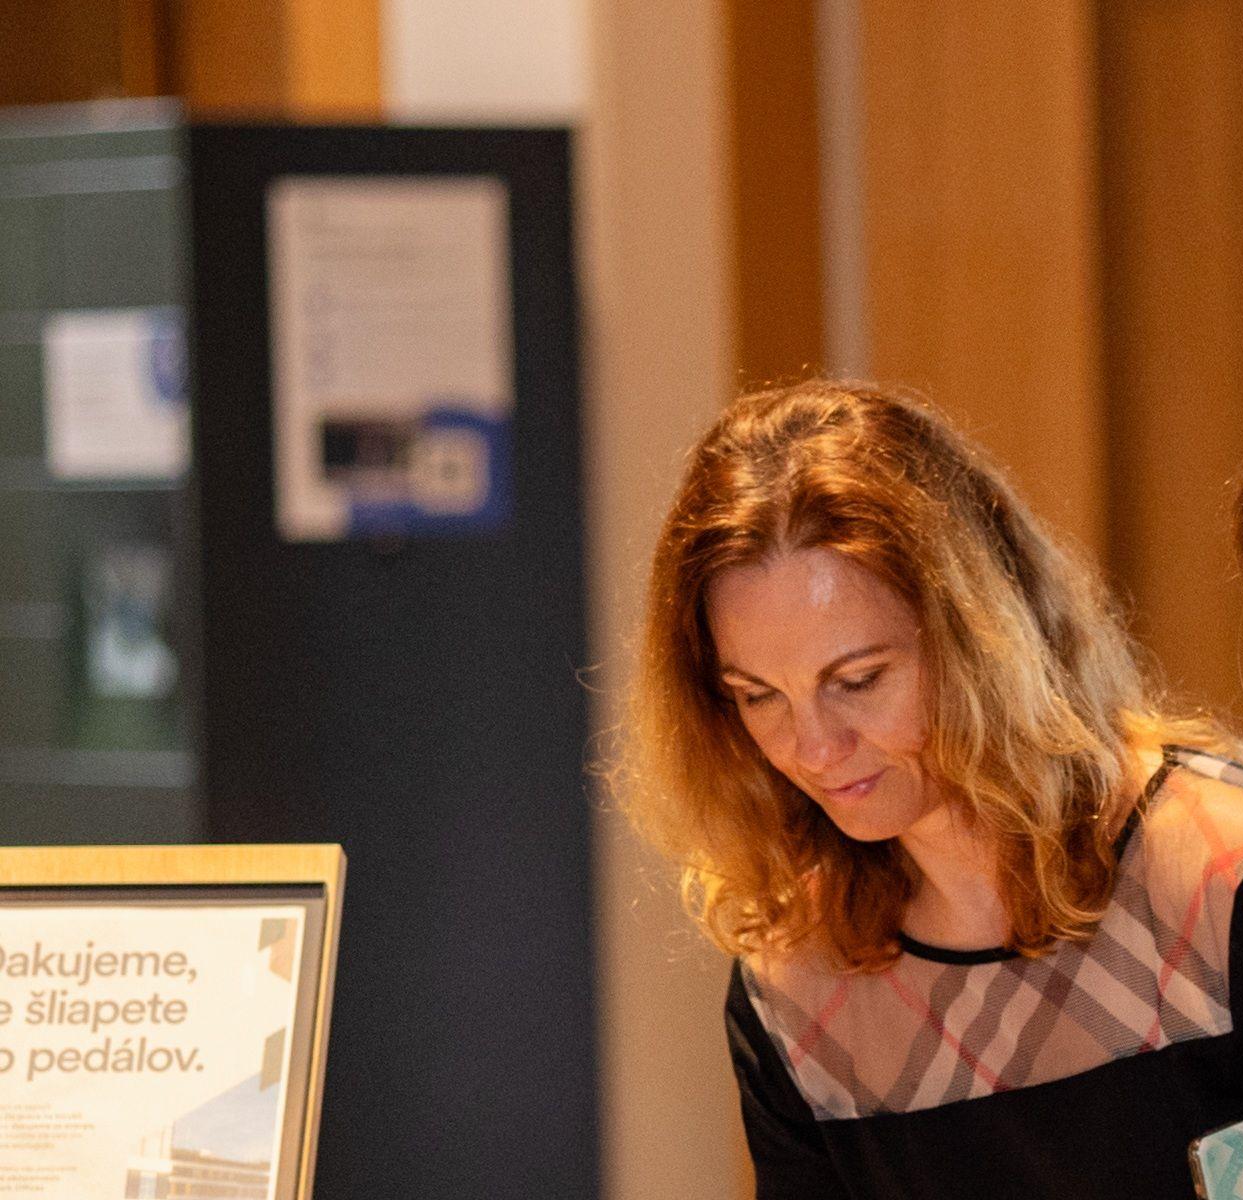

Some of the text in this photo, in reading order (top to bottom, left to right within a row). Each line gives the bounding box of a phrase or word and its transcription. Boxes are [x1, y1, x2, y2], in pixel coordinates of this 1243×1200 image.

[0, 940, 198, 986] akujeme,
[25, 989, 188, 1034] šliapete
[27, 1036, 205, 1082] pedálov.
